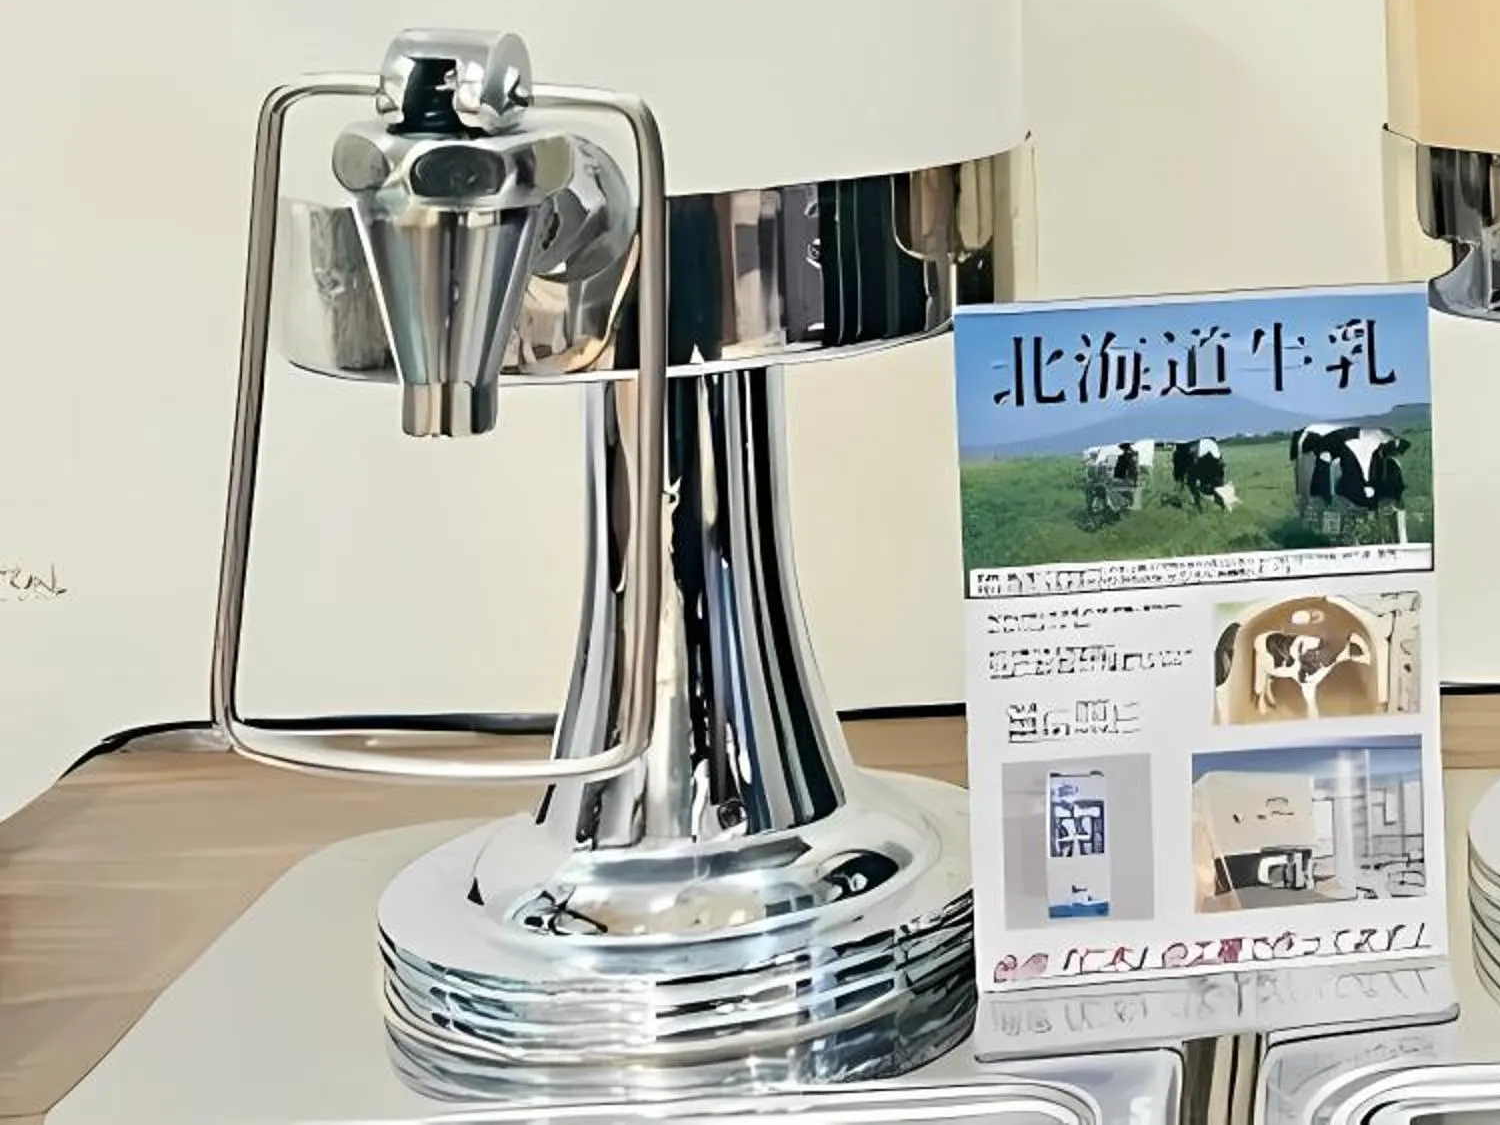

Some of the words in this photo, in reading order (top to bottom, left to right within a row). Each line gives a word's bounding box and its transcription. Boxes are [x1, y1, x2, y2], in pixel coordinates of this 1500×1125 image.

[993, 318, 1397, 407] 北海道牛乳
